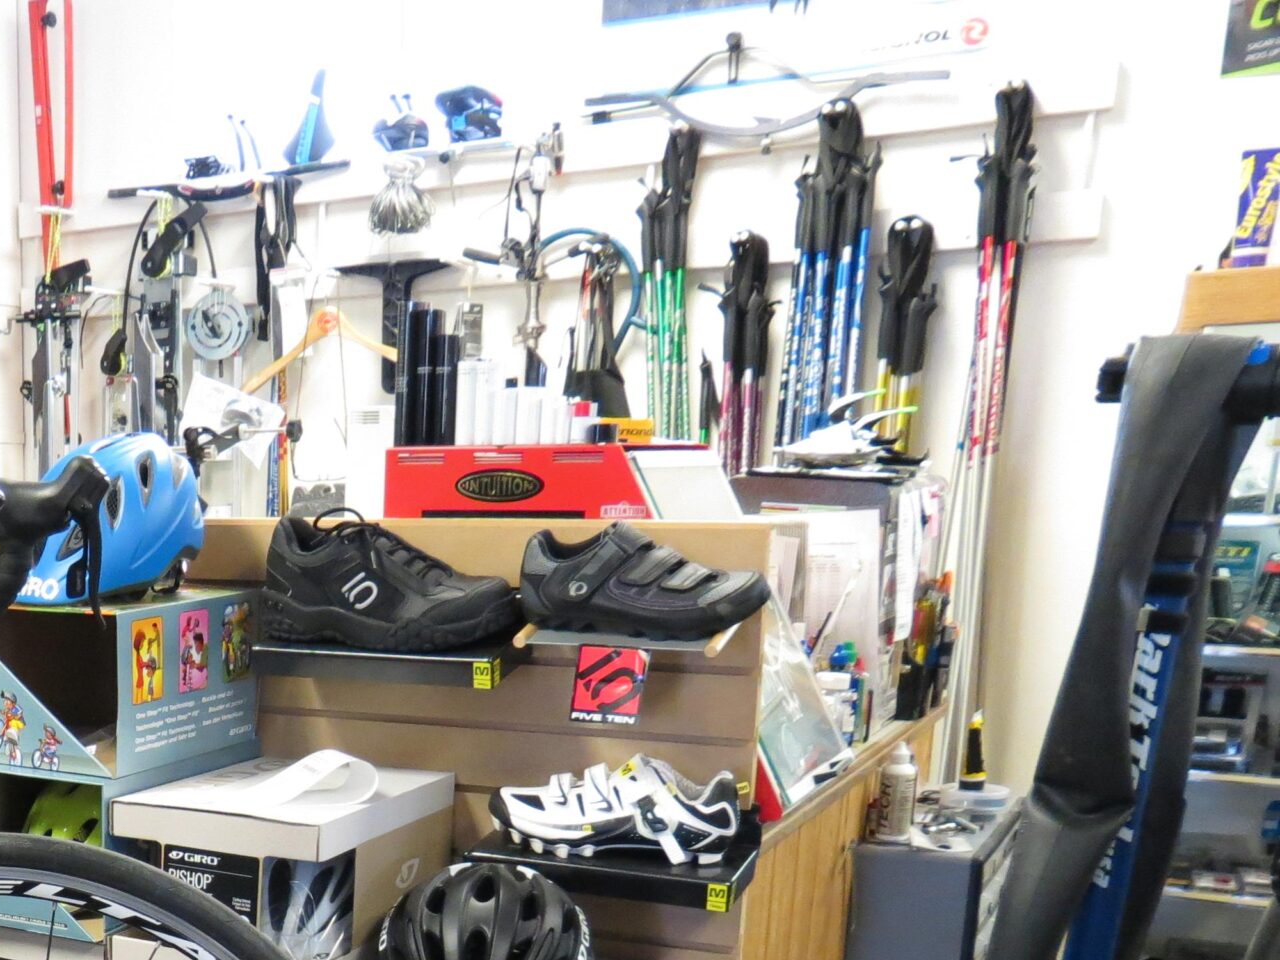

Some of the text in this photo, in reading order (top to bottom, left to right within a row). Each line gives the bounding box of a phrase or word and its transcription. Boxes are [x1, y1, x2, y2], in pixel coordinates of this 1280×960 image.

[462, 474, 534, 496] INTUITION
[602, 505, 647, 517] ATTENTION
[571, 711, 636, 725] FIVE TEN
[183, 853, 219, 866] GIRO
